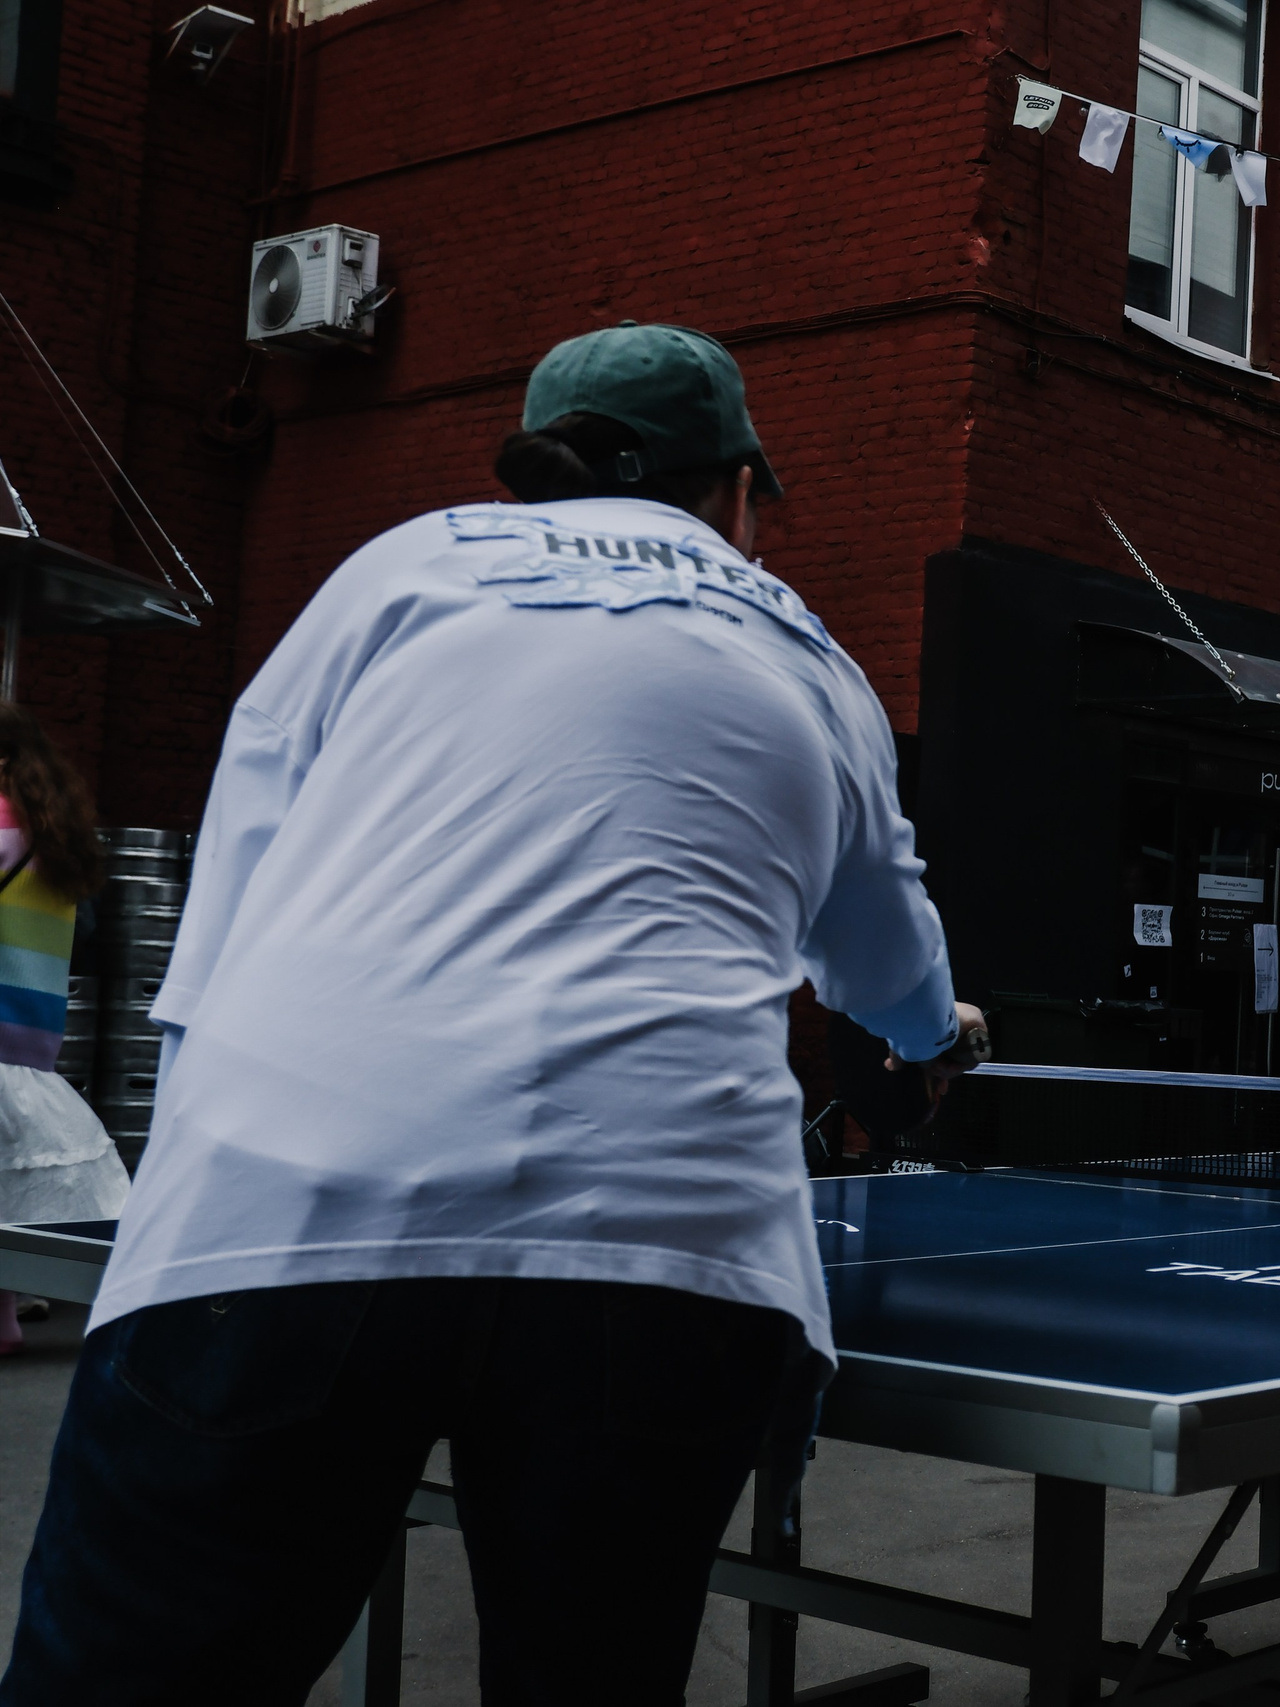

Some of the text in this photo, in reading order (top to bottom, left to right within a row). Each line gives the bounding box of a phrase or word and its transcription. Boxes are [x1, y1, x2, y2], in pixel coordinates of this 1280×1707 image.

[1201, 905, 1207, 917] 3
[1200, 929, 1206, 940] 2
[1200, 952, 1204, 963] 1
